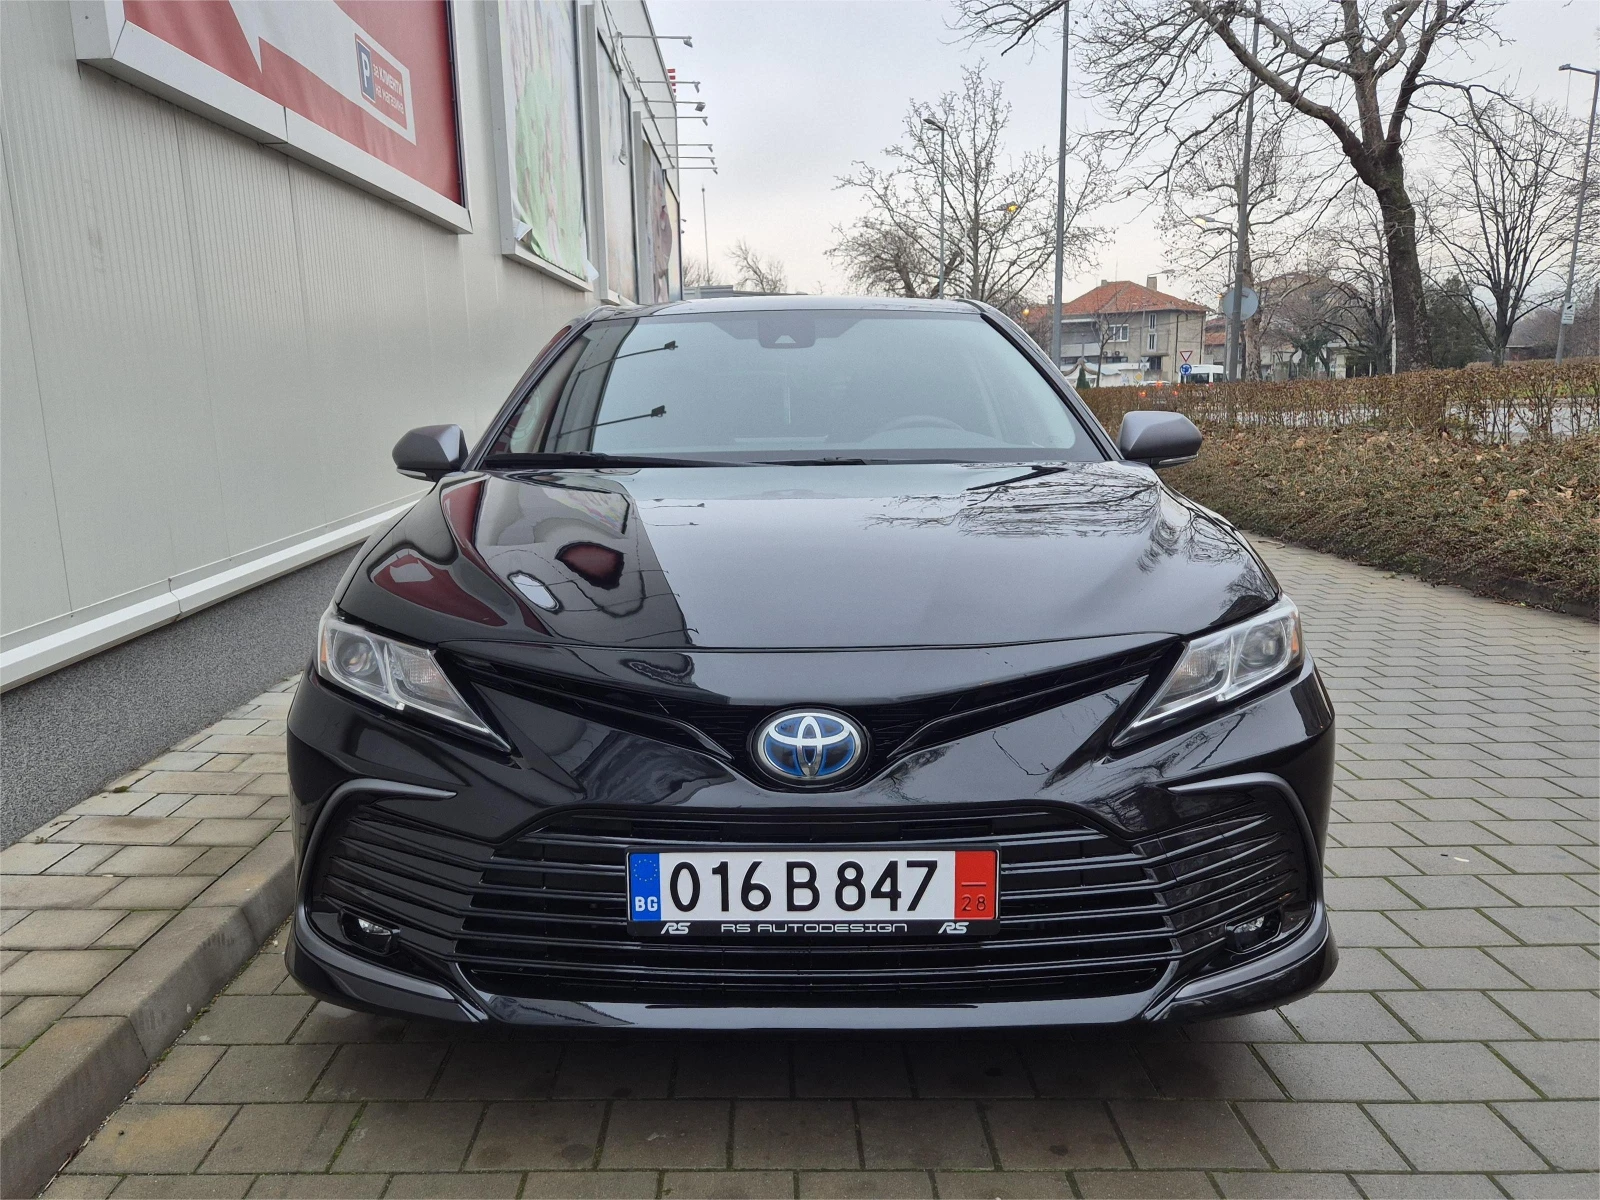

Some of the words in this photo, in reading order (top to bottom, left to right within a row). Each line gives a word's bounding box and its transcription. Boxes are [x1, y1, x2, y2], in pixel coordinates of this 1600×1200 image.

[361, 51, 370, 88] P
[669, 861, 772, 912] 016
[786, 861, 820, 912] B
[835, 860, 938, 912] 847
[634, 896, 658, 912] BG
[961, 894, 987, 912] 28
[720, 923, 751, 933] RS
[757, 923, 908, 933] AUTODESIGN
